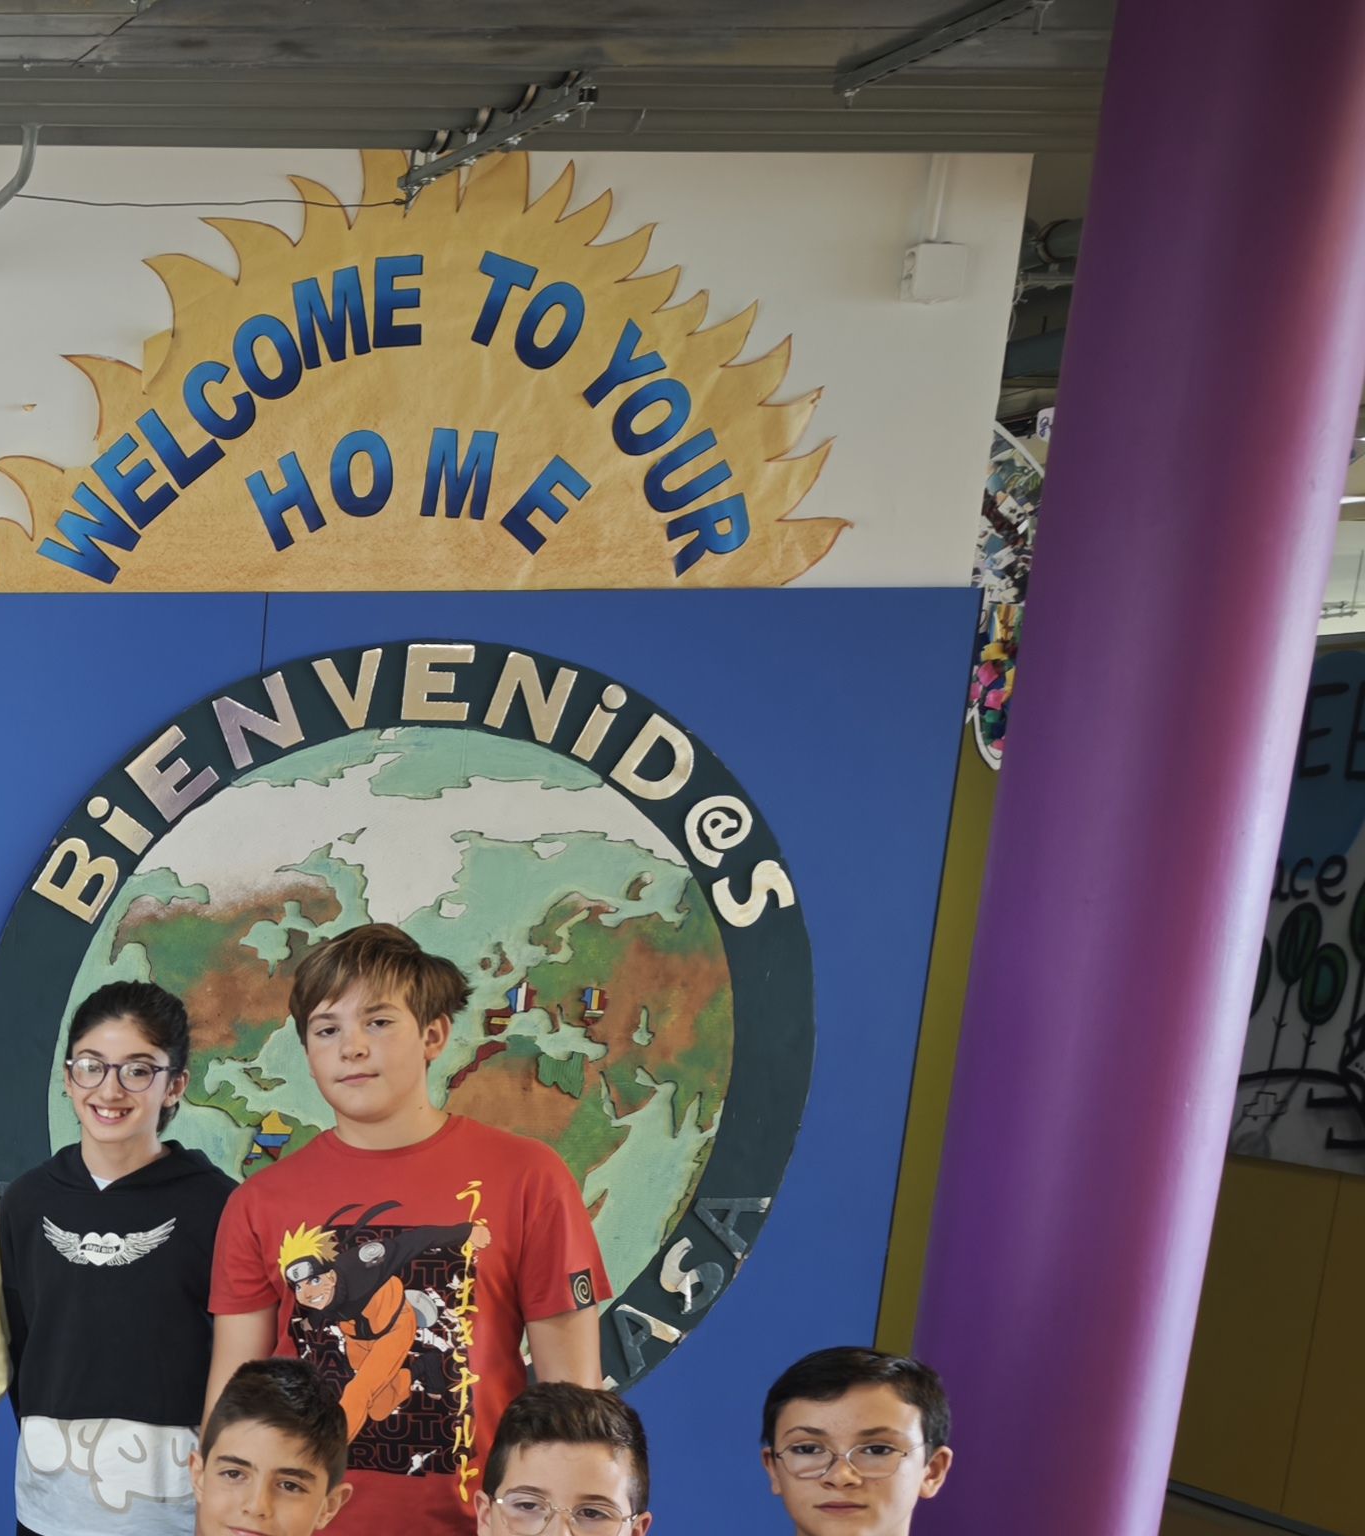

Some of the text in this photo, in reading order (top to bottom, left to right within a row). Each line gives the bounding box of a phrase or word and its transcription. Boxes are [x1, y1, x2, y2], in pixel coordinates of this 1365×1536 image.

[36, 250, 751, 584] WELCOME TO YOUR
[245, 426, 592, 556] HOME
[602, 1196, 772, 1390] ASA
